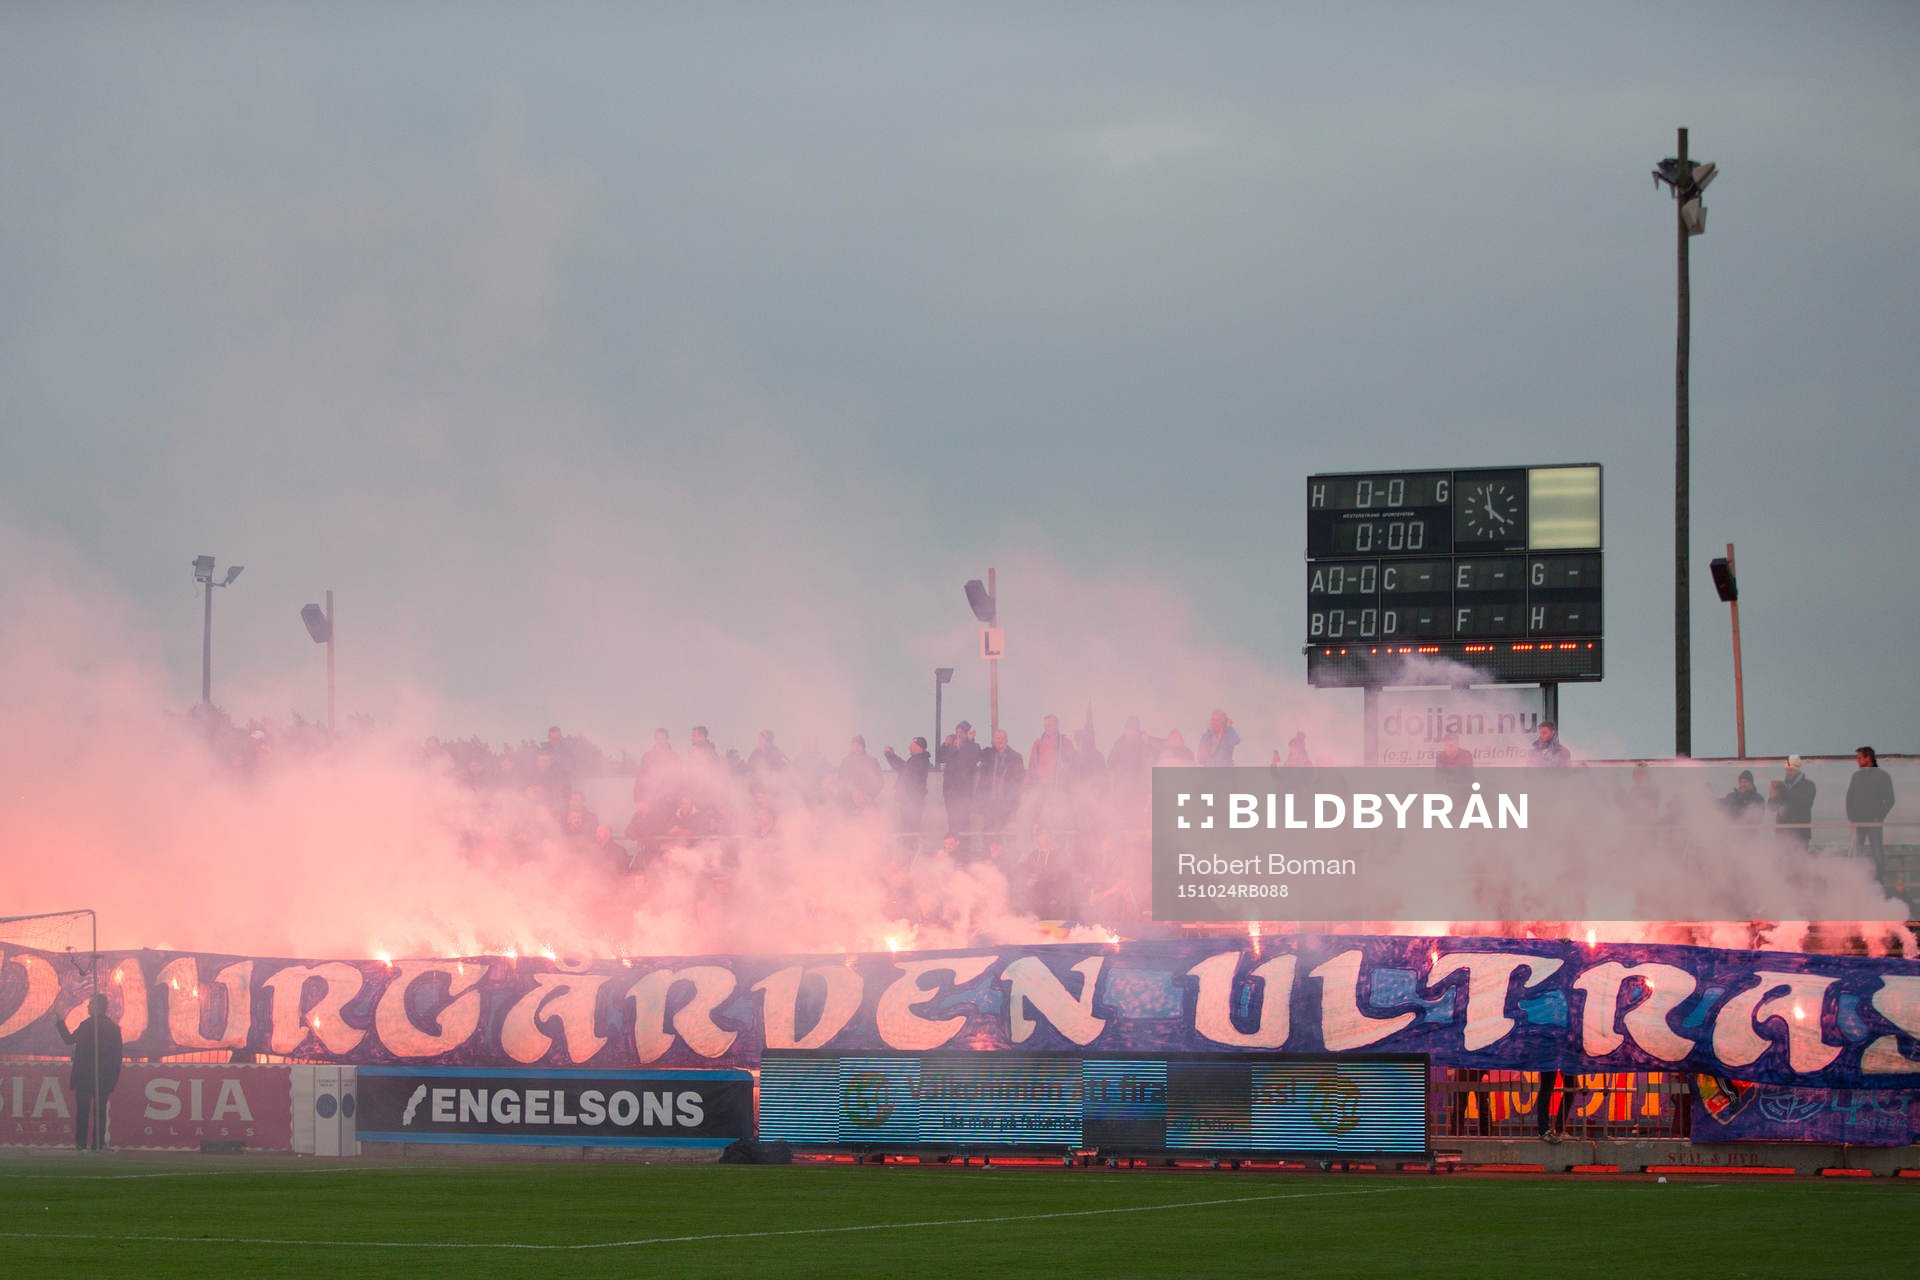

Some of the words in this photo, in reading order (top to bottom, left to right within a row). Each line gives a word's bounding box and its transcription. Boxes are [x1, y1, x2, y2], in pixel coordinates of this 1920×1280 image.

[1312, 485, 1325, 507] H
[1356, 480, 1404, 508] 0-0
[1436, 480, 1448, 502] G
[1356, 521, 1424, 551] 0:00
[985, 631, 1000, 656] L
[1383, 707, 1537, 743] dojjan.nu
[1187, 949, 1920, 1076] ULTRAS
[0, 1076, 71, 1119] IA
[143, 1077, 255, 1122] SIA
[431, 1088, 705, 1128] ENGELSONS
[144, 1126, 256, 1137] GLASS
